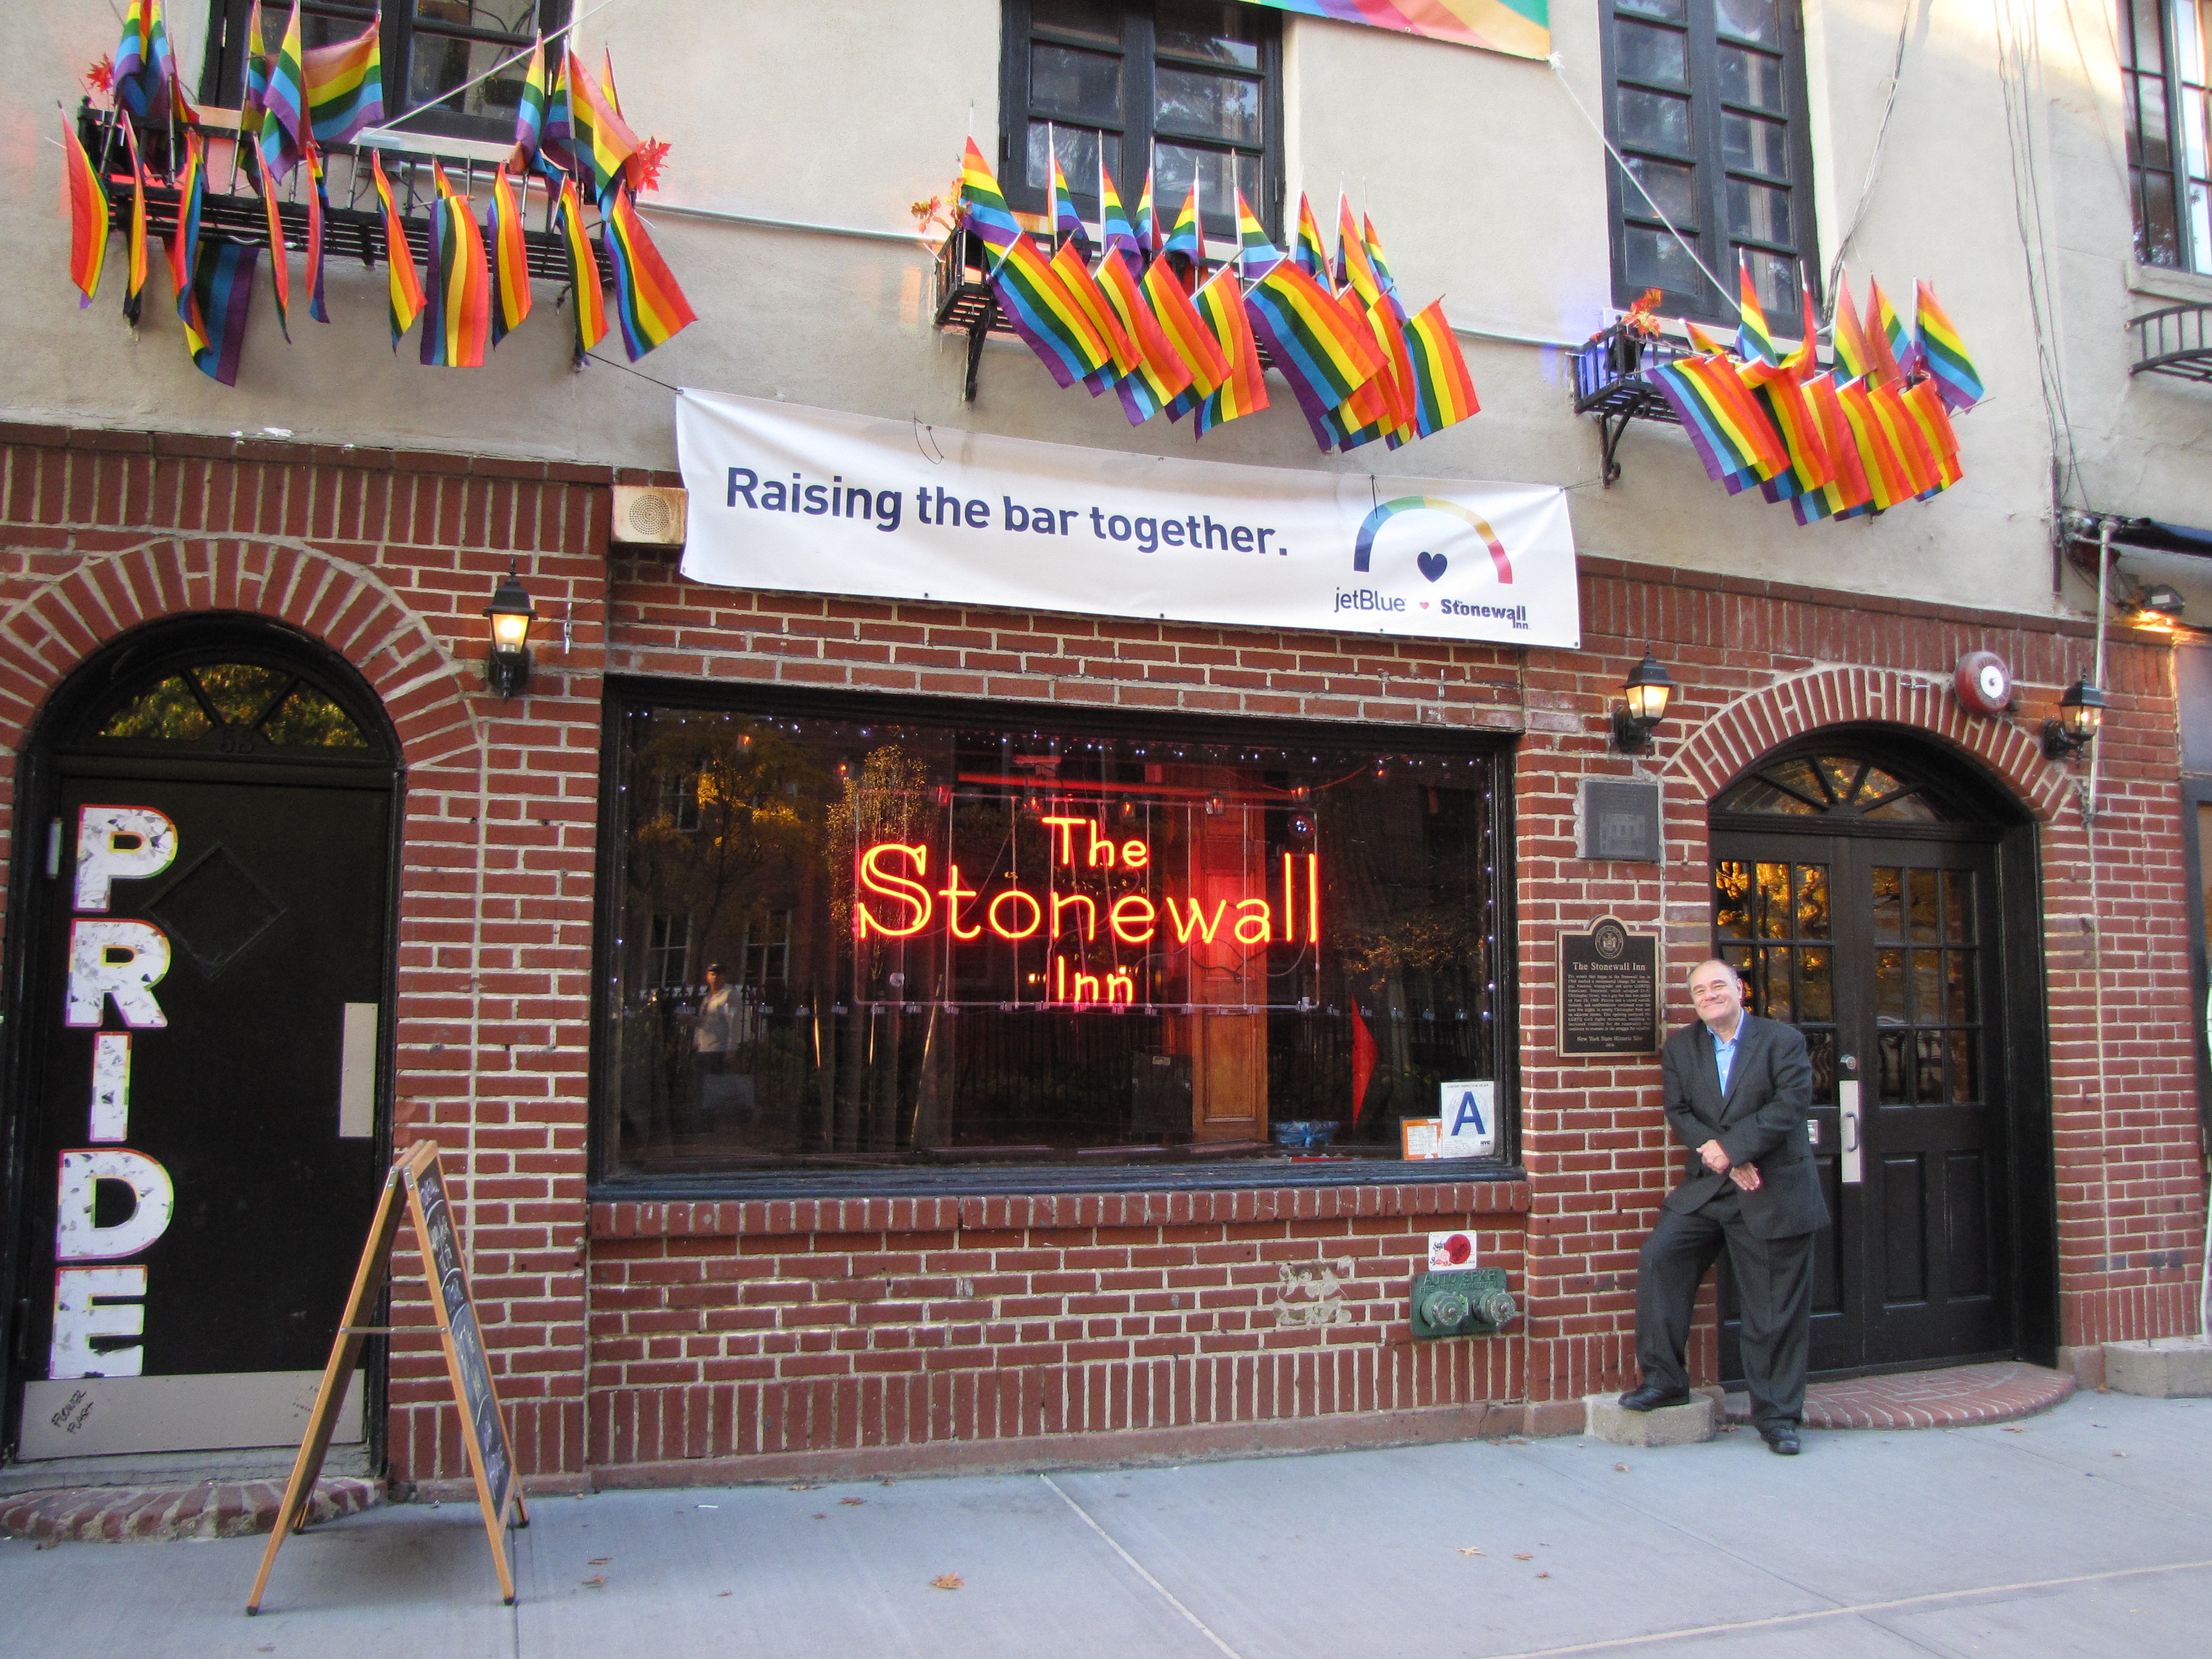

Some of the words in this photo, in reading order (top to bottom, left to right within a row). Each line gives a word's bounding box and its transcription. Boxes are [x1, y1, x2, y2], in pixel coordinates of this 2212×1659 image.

[727, 467, 902, 531] Raising
[916, 486, 990, 529] the
[1003, 495, 1079, 536] bar
[1090, 506, 1288, 556] together.
[1334, 586, 1406, 612] jetBlue
[1440, 598, 1526, 621] Stonewall
[1042, 816, 1149, 867] The
[857, 842, 1318, 944] Stonewall
[1057, 955, 1134, 1003] Inn
[1590, 962, 1629, 971] Stonewall
[49, 803, 178, 1379] PRIDE
[1451, 1091, 1486, 1136] A
[1423, 1272, 1456, 1285] AUTO
[1463, 1269, 1496, 1282] SPKR
